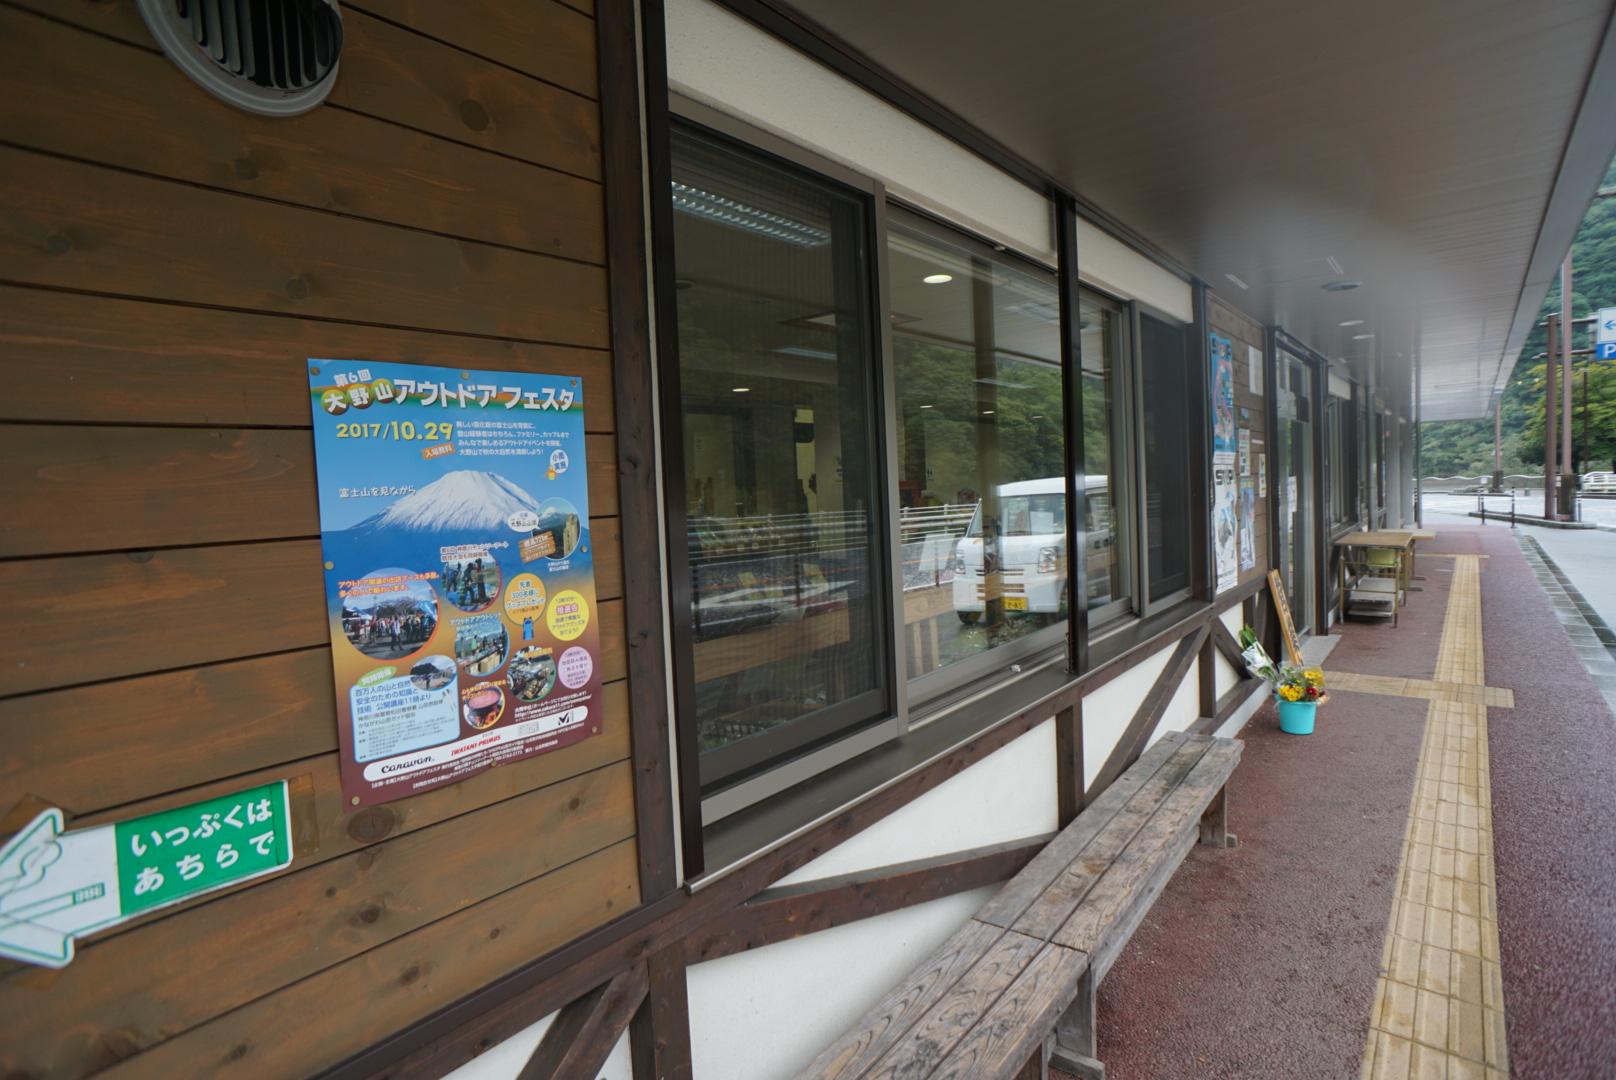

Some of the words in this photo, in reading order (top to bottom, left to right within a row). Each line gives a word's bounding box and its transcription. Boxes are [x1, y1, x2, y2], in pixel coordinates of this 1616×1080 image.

[336, 420, 454, 441] 2017/10.29
[338, 486, 416, 498] 富士山を見ながら
[134, 830, 275, 895] あちらで
